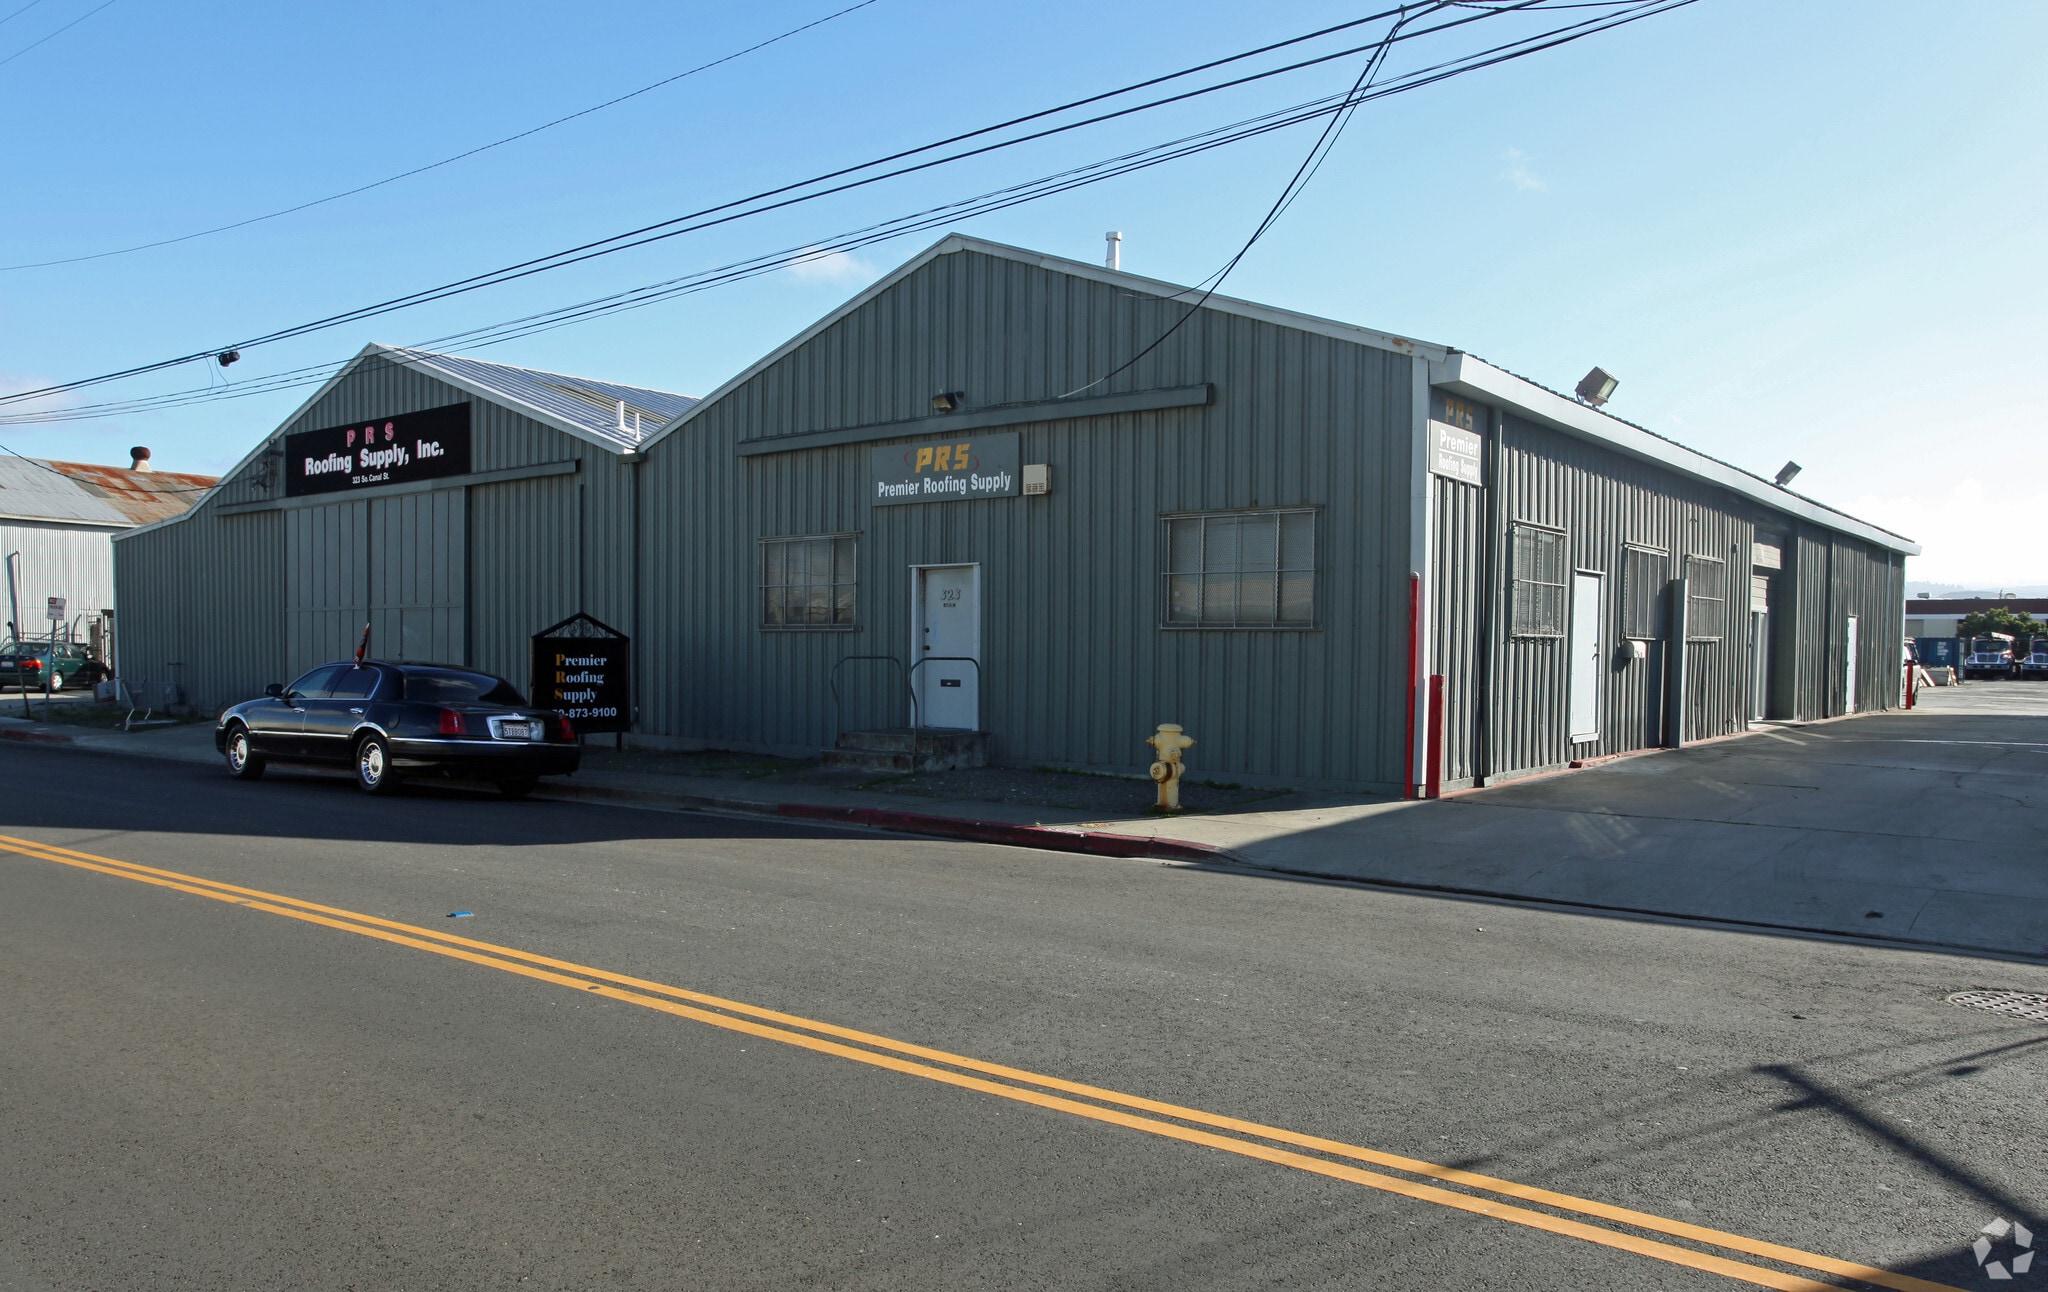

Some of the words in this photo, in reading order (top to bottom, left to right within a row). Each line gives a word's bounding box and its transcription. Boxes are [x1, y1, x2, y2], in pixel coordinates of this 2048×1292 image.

[1439, 428, 1478, 456] Premier
[304, 452, 353, 476] Roofing
[359, 442, 410, 470] Supply,
[416, 438, 444, 460] Inc.
[914, 443, 971, 474] PRS
[1438, 452, 1459, 476] Roofing
[1460, 458, 1478, 481] Supply
[878, 480, 920, 498] Premier
[923, 475, 967, 495] Roofing
[970, 471, 1011, 492] Supply
[939, 587, 962, 601] 323
[555, 653, 607, 667] Premier
[555, 670, 604, 686] Roofing
[554, 687, 597, 703] Supply
